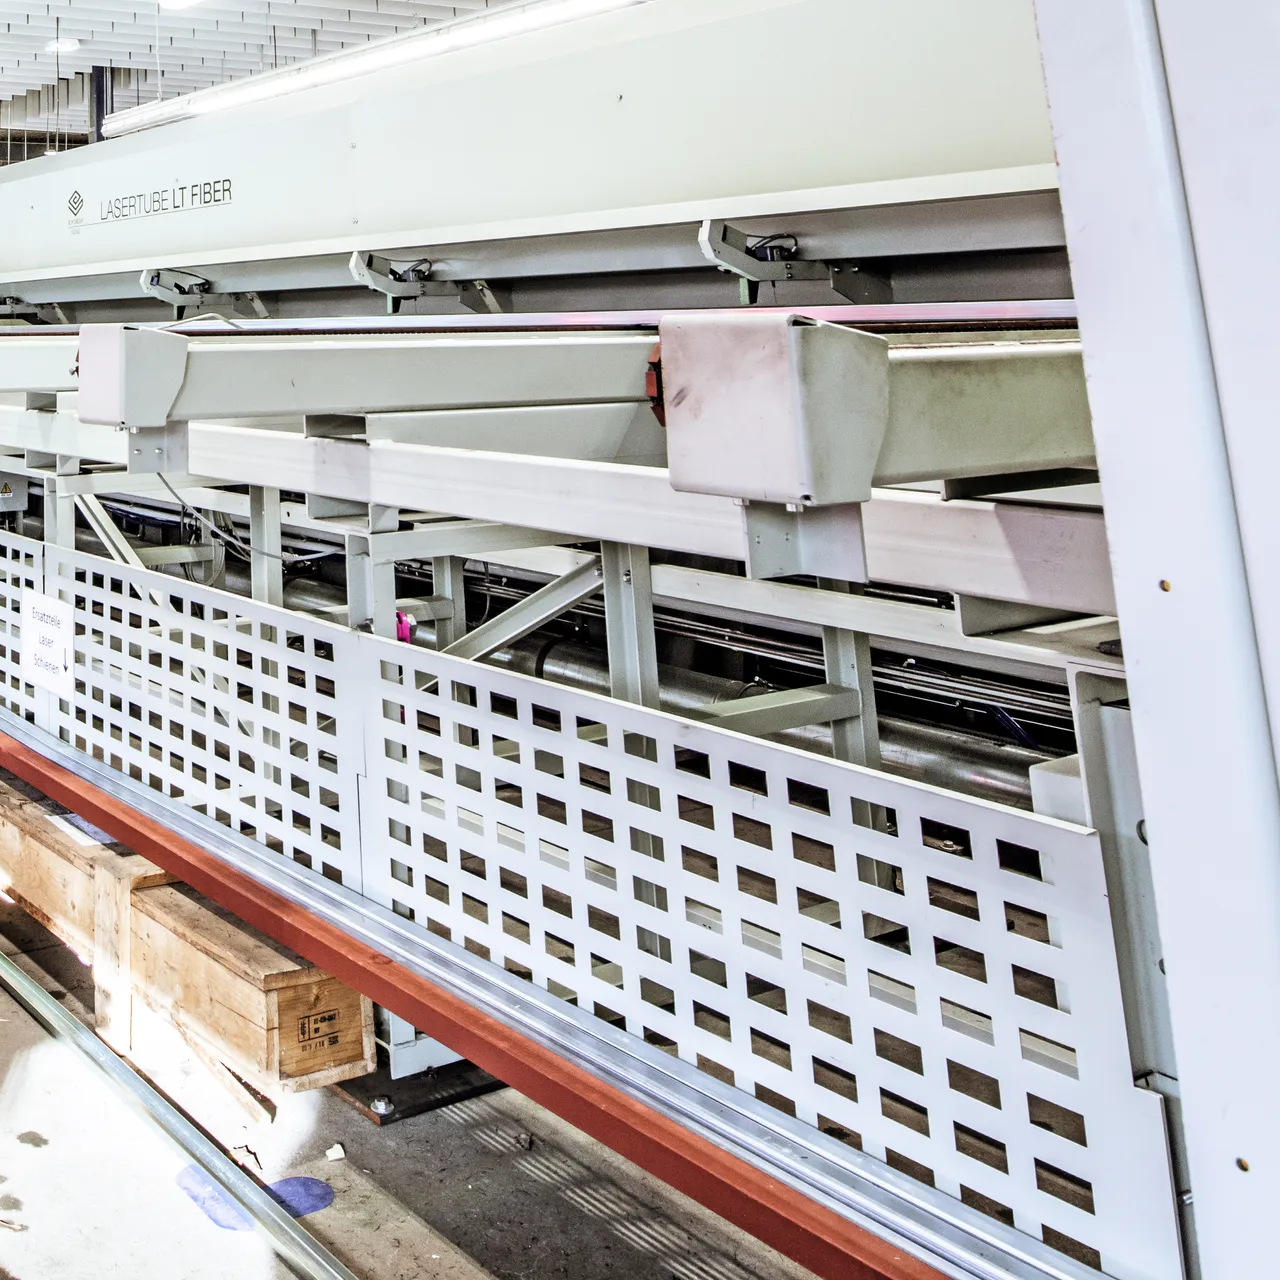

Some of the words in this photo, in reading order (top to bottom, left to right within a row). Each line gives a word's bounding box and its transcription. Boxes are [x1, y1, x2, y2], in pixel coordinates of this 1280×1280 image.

[100, 190, 169, 220] LASERTUBE
[172, 186, 187, 209] LT
[191, 179, 232, 206] FIBER
[32, 606, 61, 629] Ersatzteile
[38, 631, 54, 649] Laser
[34, 653, 60, 677] Schienen
